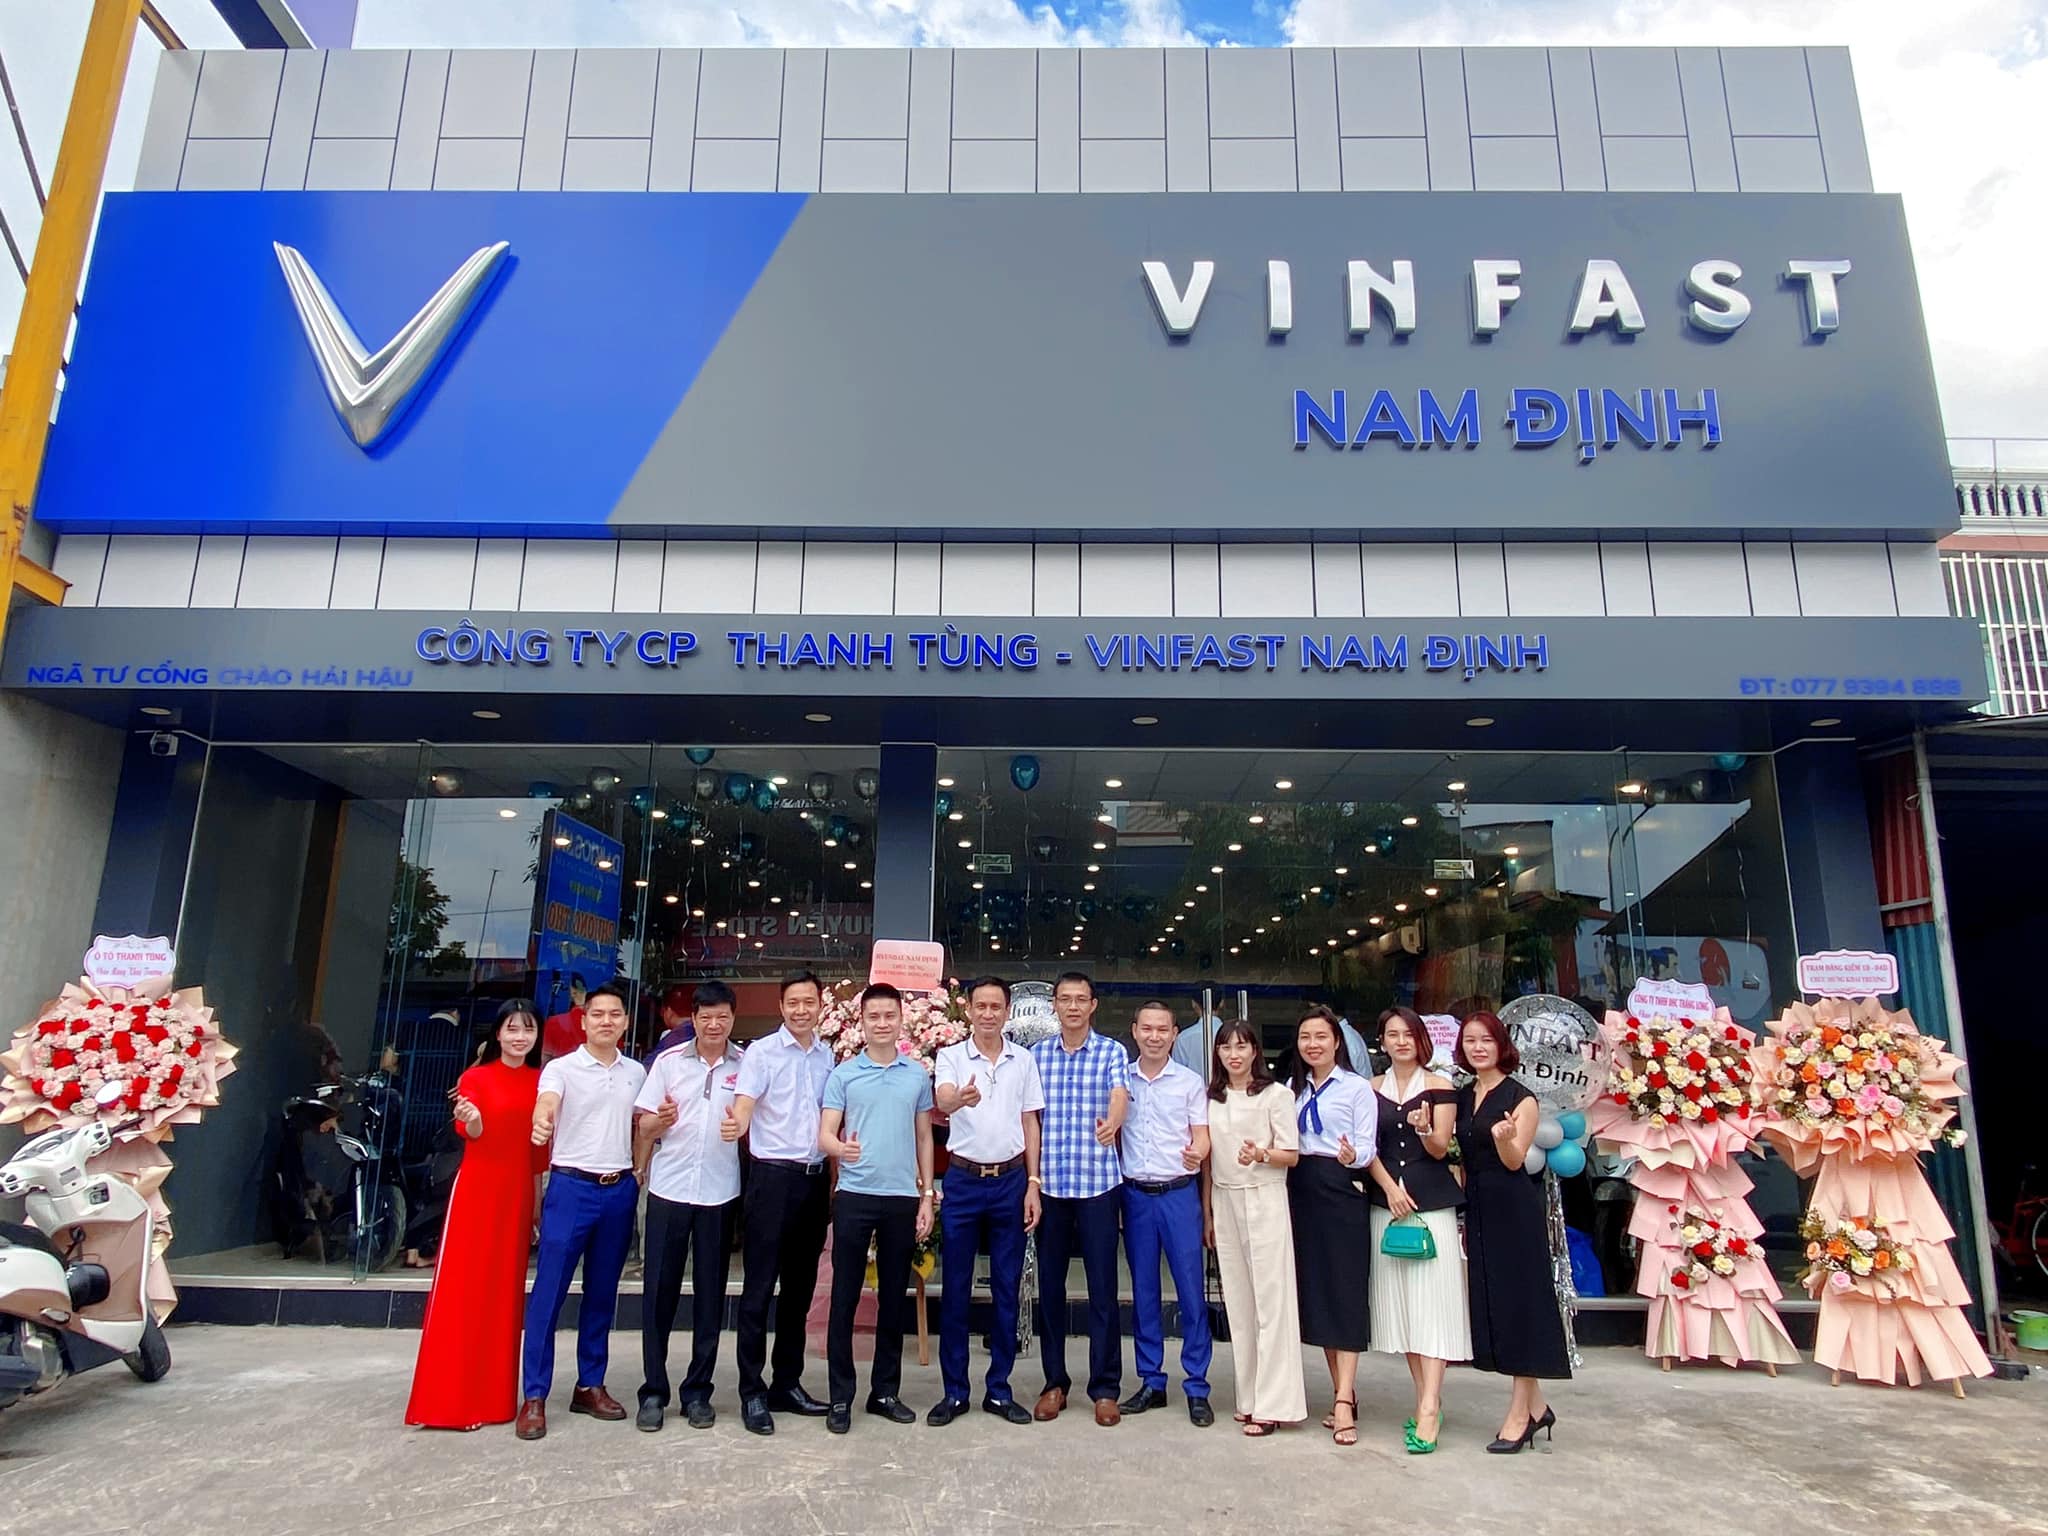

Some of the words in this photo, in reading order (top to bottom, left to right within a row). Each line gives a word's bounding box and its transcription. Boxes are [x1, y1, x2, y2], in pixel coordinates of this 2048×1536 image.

[1141, 259, 1851, 336] VINFAST
[1293, 388, 1480, 446] NAM
[1505, 387, 1722, 461] ĐỊNH
[27, 662, 83, 684] NGÃ
[91, 664, 130, 684] TƯ
[135, 658, 208, 684] CỔNG
[415, 618, 550, 664] CÔNG
[563, 628, 629, 664] TY
[635, 629, 698, 665] CP
[727, 630, 894, 668] THANH
[908, 622, 1039, 669] TÙNG
[1086, 632, 1287, 669] VINFAST
[1300, 634, 1408, 671] NAM
[1422, 634, 1549, 681] ĐỊNH
[1535, 1061, 1589, 1087] Định
